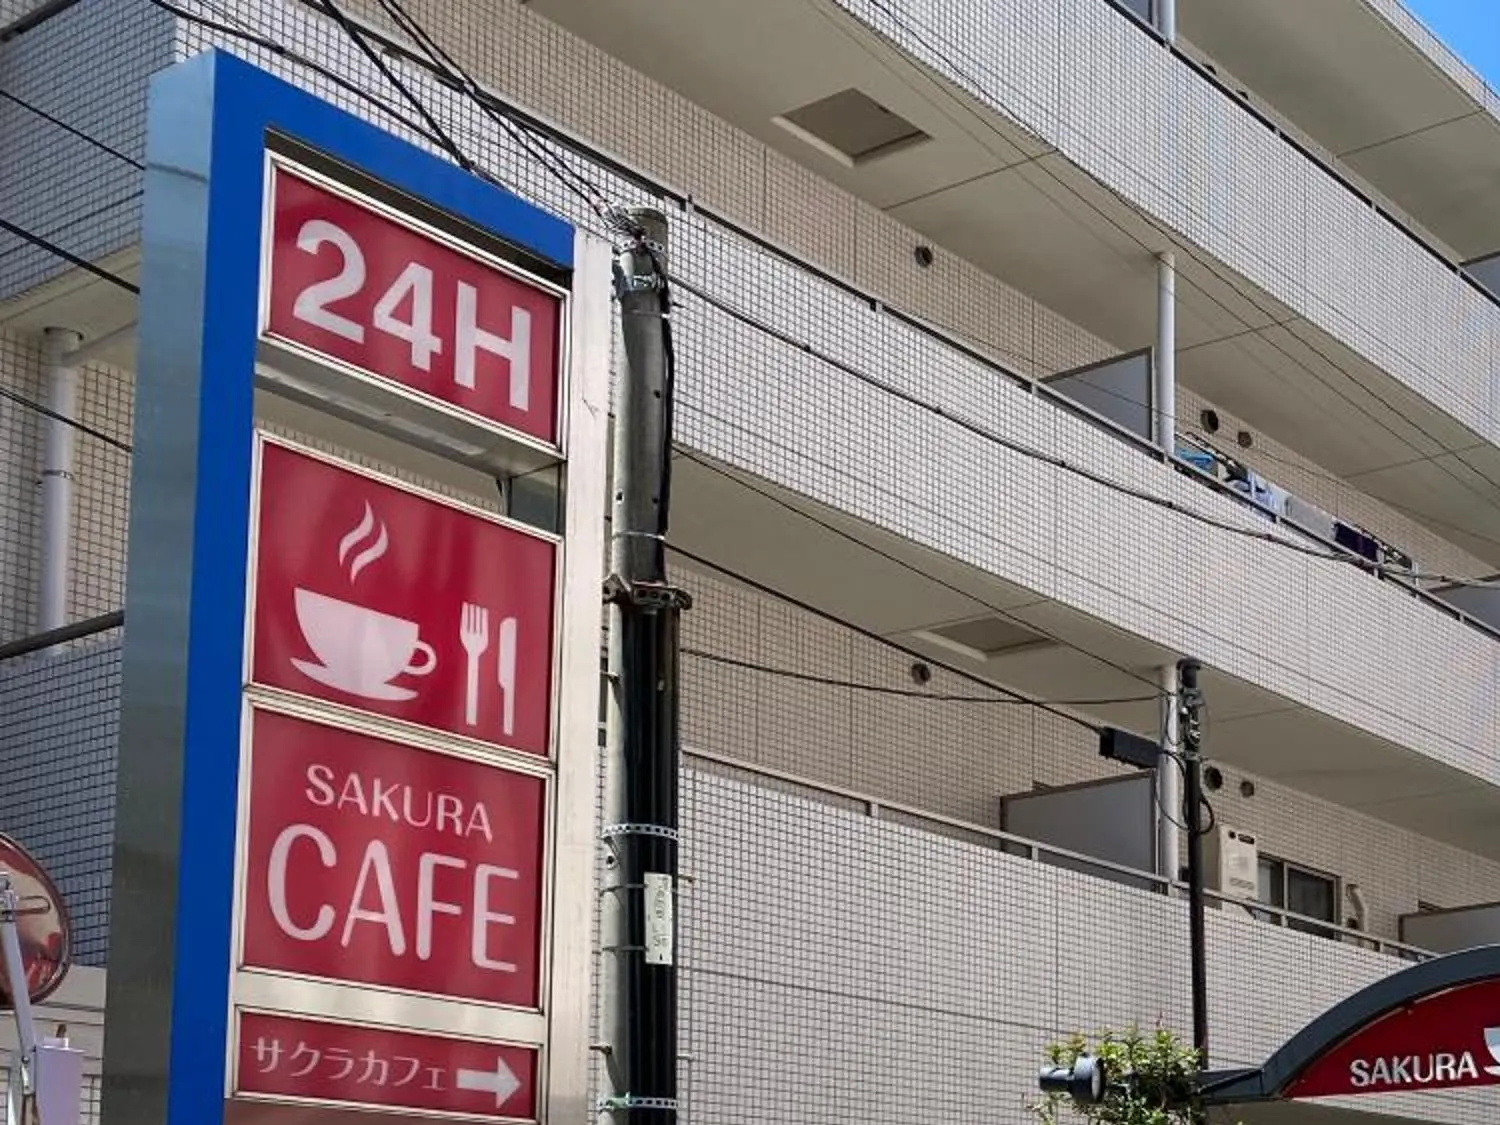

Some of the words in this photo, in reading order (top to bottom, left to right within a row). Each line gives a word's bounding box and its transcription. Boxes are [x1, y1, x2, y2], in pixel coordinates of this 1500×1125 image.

[292, 218, 532, 411] 24H
[306, 765, 493, 842] SAKURA
[267, 824, 519, 973] CAFE
[251, 1037, 447, 1091] サクラカフェ
[1350, 1053, 1480, 1087] SAKURA
